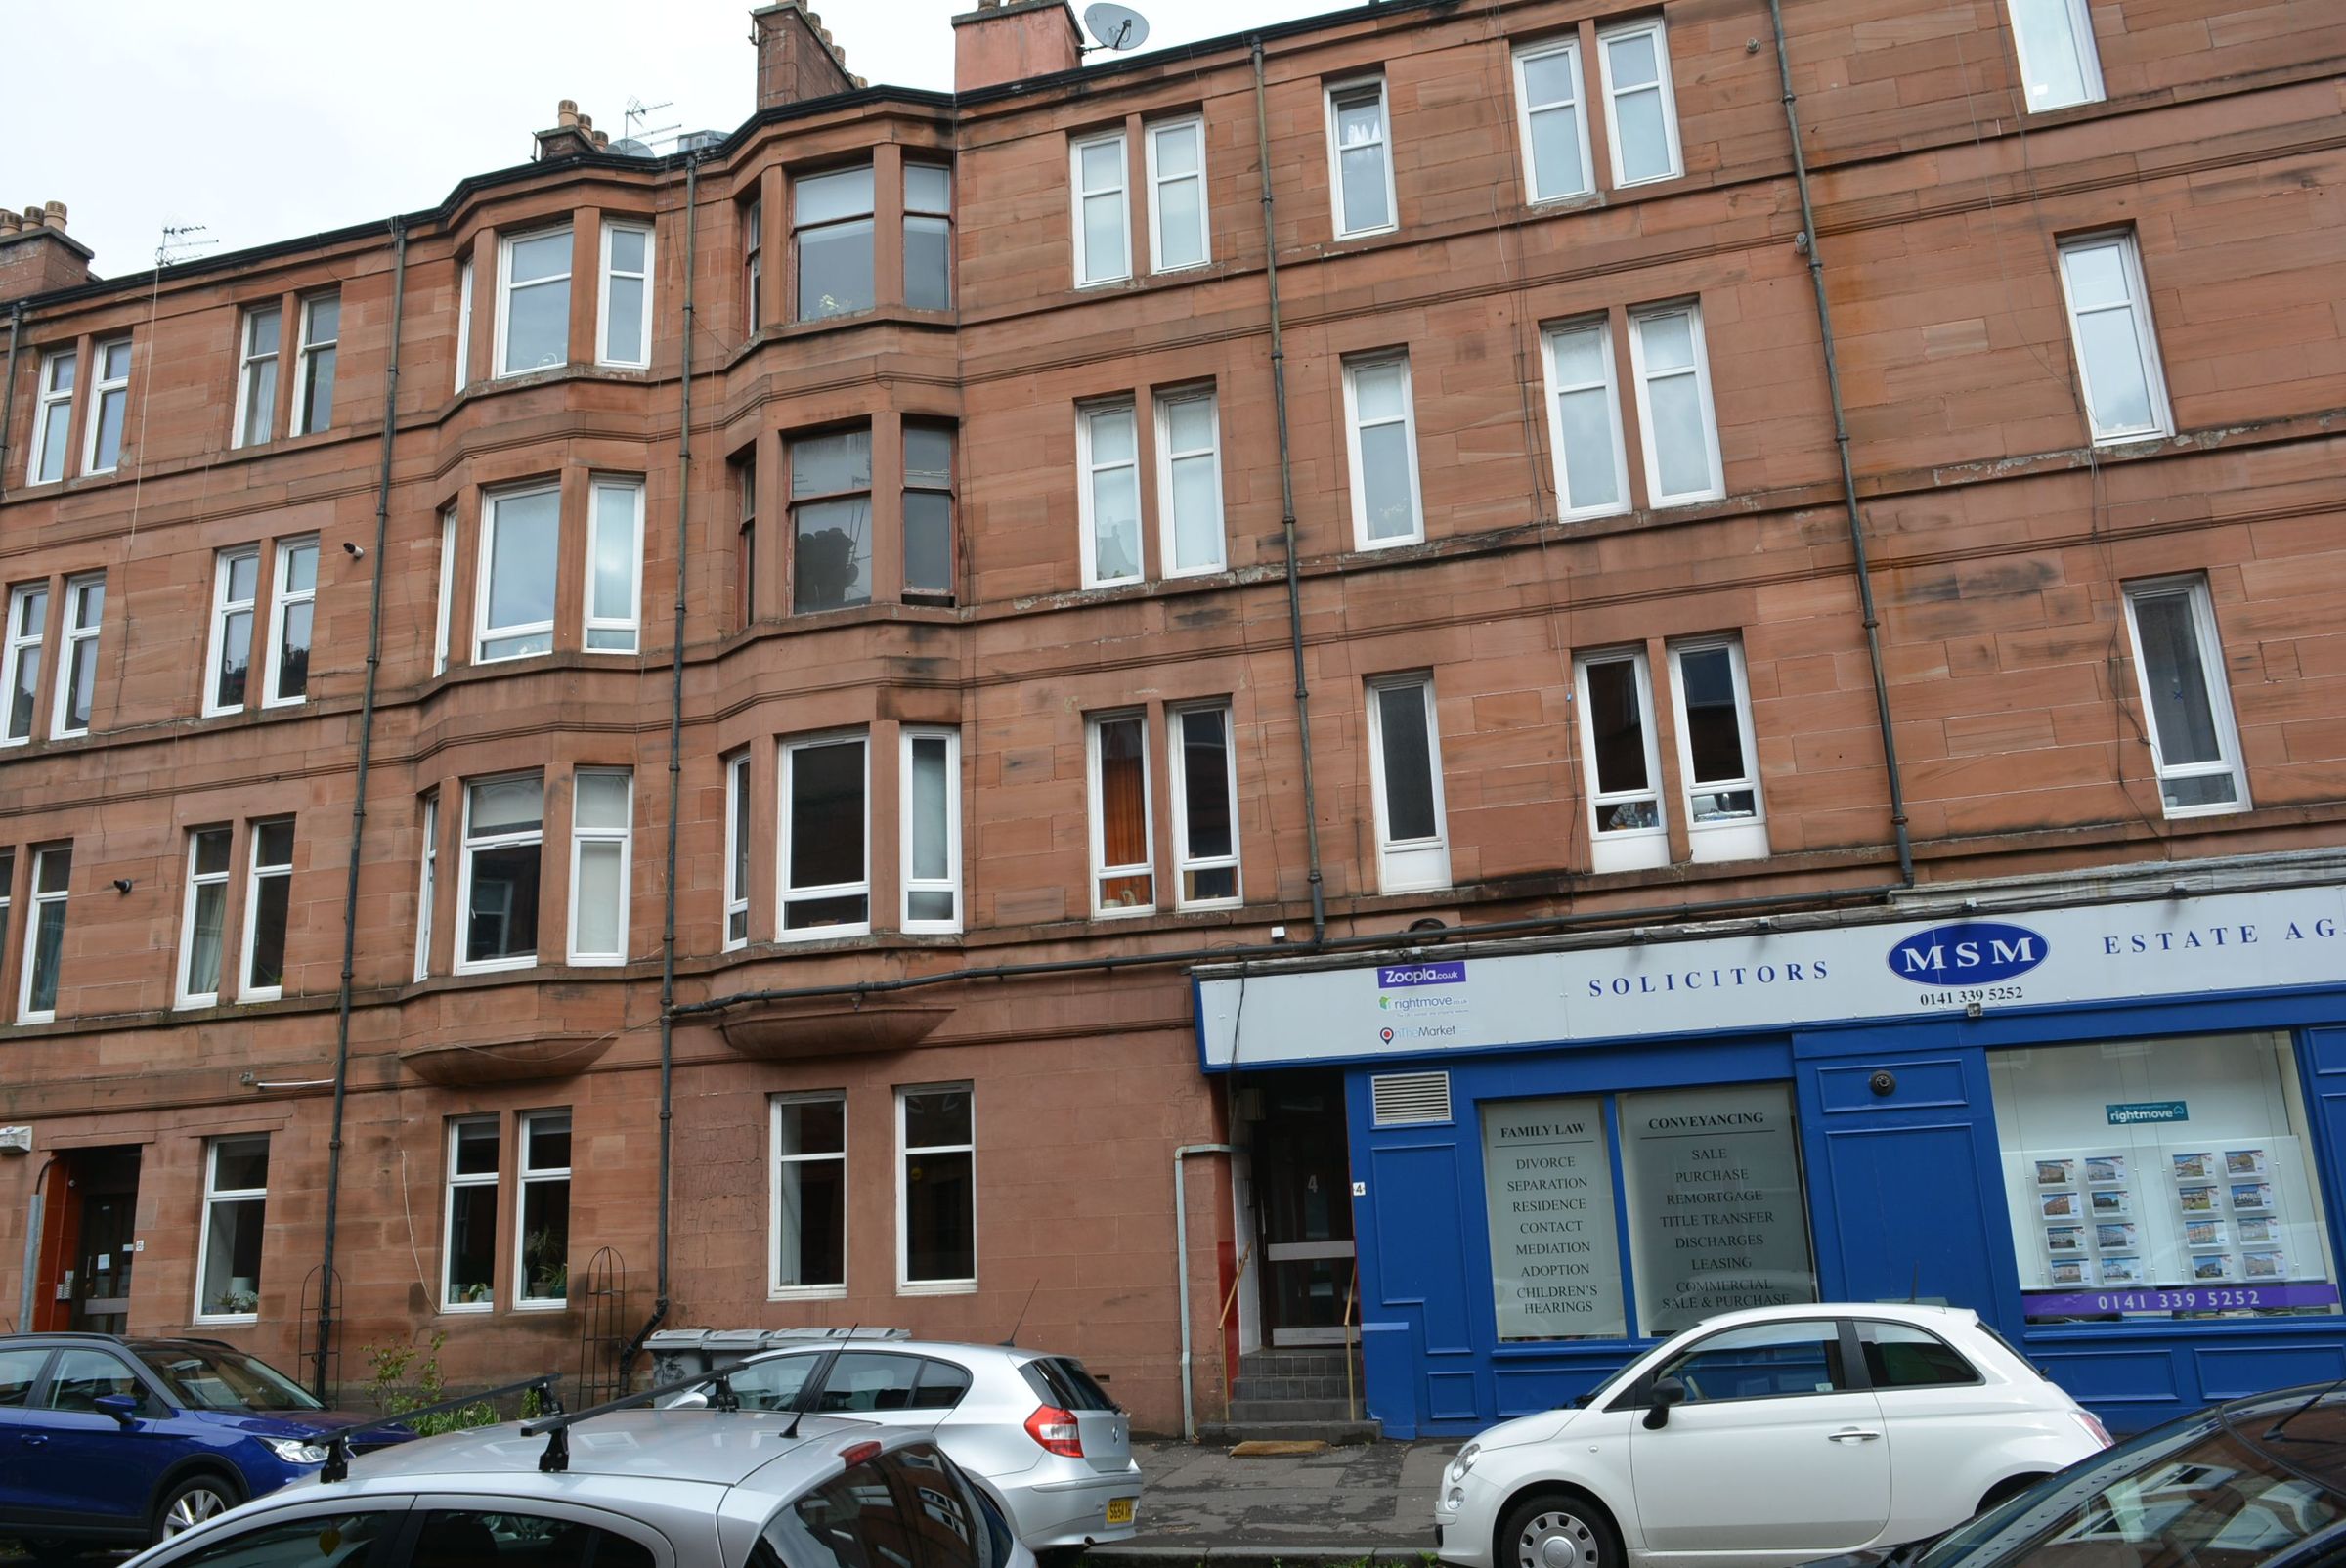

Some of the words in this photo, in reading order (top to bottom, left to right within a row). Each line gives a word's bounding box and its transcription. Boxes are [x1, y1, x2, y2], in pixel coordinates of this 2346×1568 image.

[2103, 924, 2258, 955] ESTATE
[2285, 918, 2346, 940] AG
[1902, 936, 2036, 973] MSM
[1385, 968, 1458, 983] Zoopla.co.uk
[1588, 961, 1827, 997] SOLICITORS
[1920, 992, 1953, 1006] 0141
[1958, 989, 1983, 1003] 339
[1988, 986, 2023, 1001] 5252
[1648, 1111, 1764, 1130] CONVEYANCING
[2111, 1110, 2174, 1123] rightmove
[1500, 1124, 1552, 1138] FAMILY
[1555, 1122, 1586, 1135] LAW
[1692, 1148, 1728, 1160] SALE
[1516, 1156, 1576, 1170] DIVORCE
[1675, 1168, 1749, 1183] PURCHASE
[1308, 1174, 1318, 1193] 4
[1507, 1177, 1588, 1192] SEPARATION
[1667, 1190, 1763, 1205] REMORTGAGE
[1512, 1198, 1586, 1213] RESIDENCE
[1520, 1220, 1584, 1234] CONTACT
[1660, 1214, 1699, 1228] TITLE
[1701, 1211, 1774, 1226] TRANSFER
[1516, 1241, 1591, 1255] MEDIATION
[1675, 1234, 1764, 1249] DISCHARGES
[1521, 1263, 1589, 1278] ADOPTION
[1692, 1257, 1752, 1271] LEASING
[1517, 1285, 1598, 1299] CHILDREN'S
[1676, 1279, 1774, 1293] COMMERCIAL
[1524, 1300, 1593, 1314] HEARINGS
[1663, 1296, 1697, 1310] SALE
[1701, 1296, 1712, 1308] &
[1716, 1293, 1791, 1308] PURCHASE
[2098, 1294, 2146, 1310] 0141
[2158, 1292, 2195, 1308] 339
[2208, 1290, 2260, 1306] 5252
